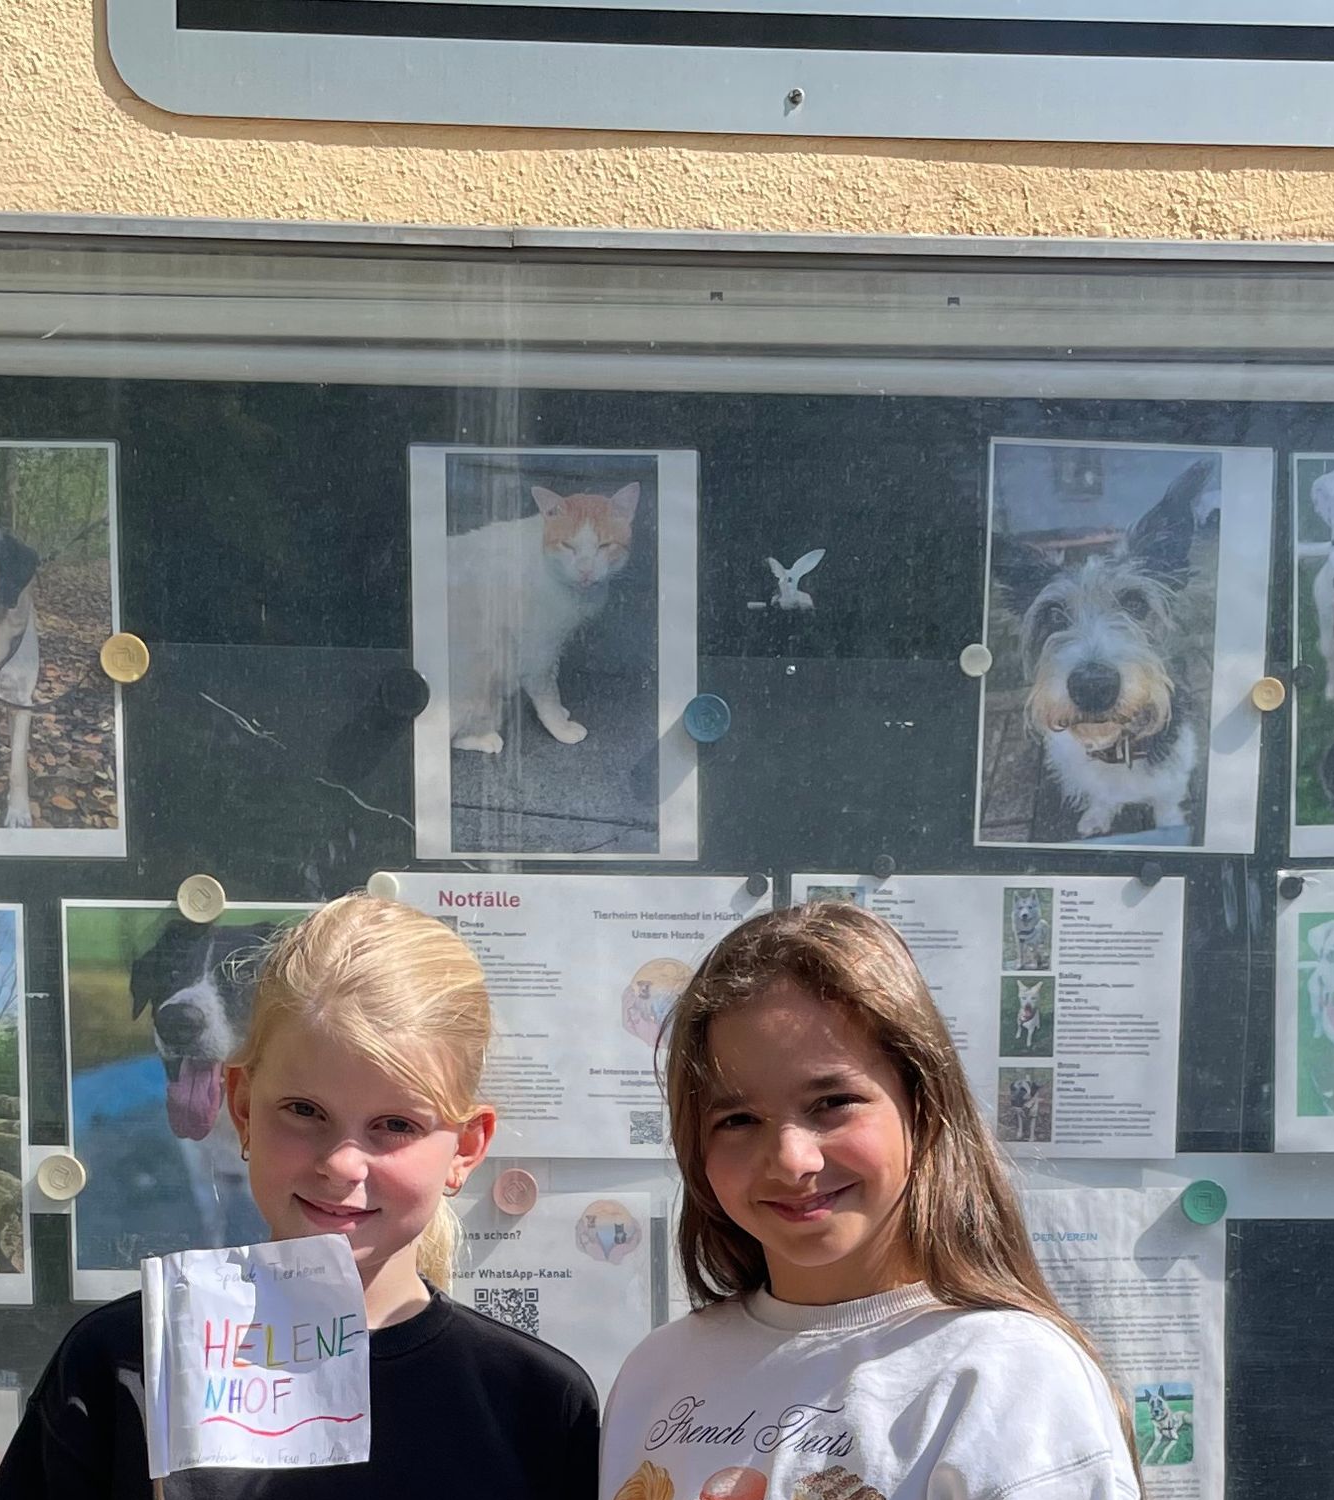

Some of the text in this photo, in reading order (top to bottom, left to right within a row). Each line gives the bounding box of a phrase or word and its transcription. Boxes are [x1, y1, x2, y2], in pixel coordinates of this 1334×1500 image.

[438, 890, 521, 908] Notfälle
[593, 910, 744, 921] Tierheim Helenenhof in Hürth
[632, 930, 705, 940] Unsere Hunde
[483, 1230, 522, 1241] schon?
[1032, 1232, 1098, 1242] DER VEREIN
[478, 1268, 574, 1281] WhatsApp-Kanal:
[204, 1313, 365, 1369] HELENE
[205, 1377, 294, 1414] NHOF
[644, 1395, 856, 1459] French Treats
